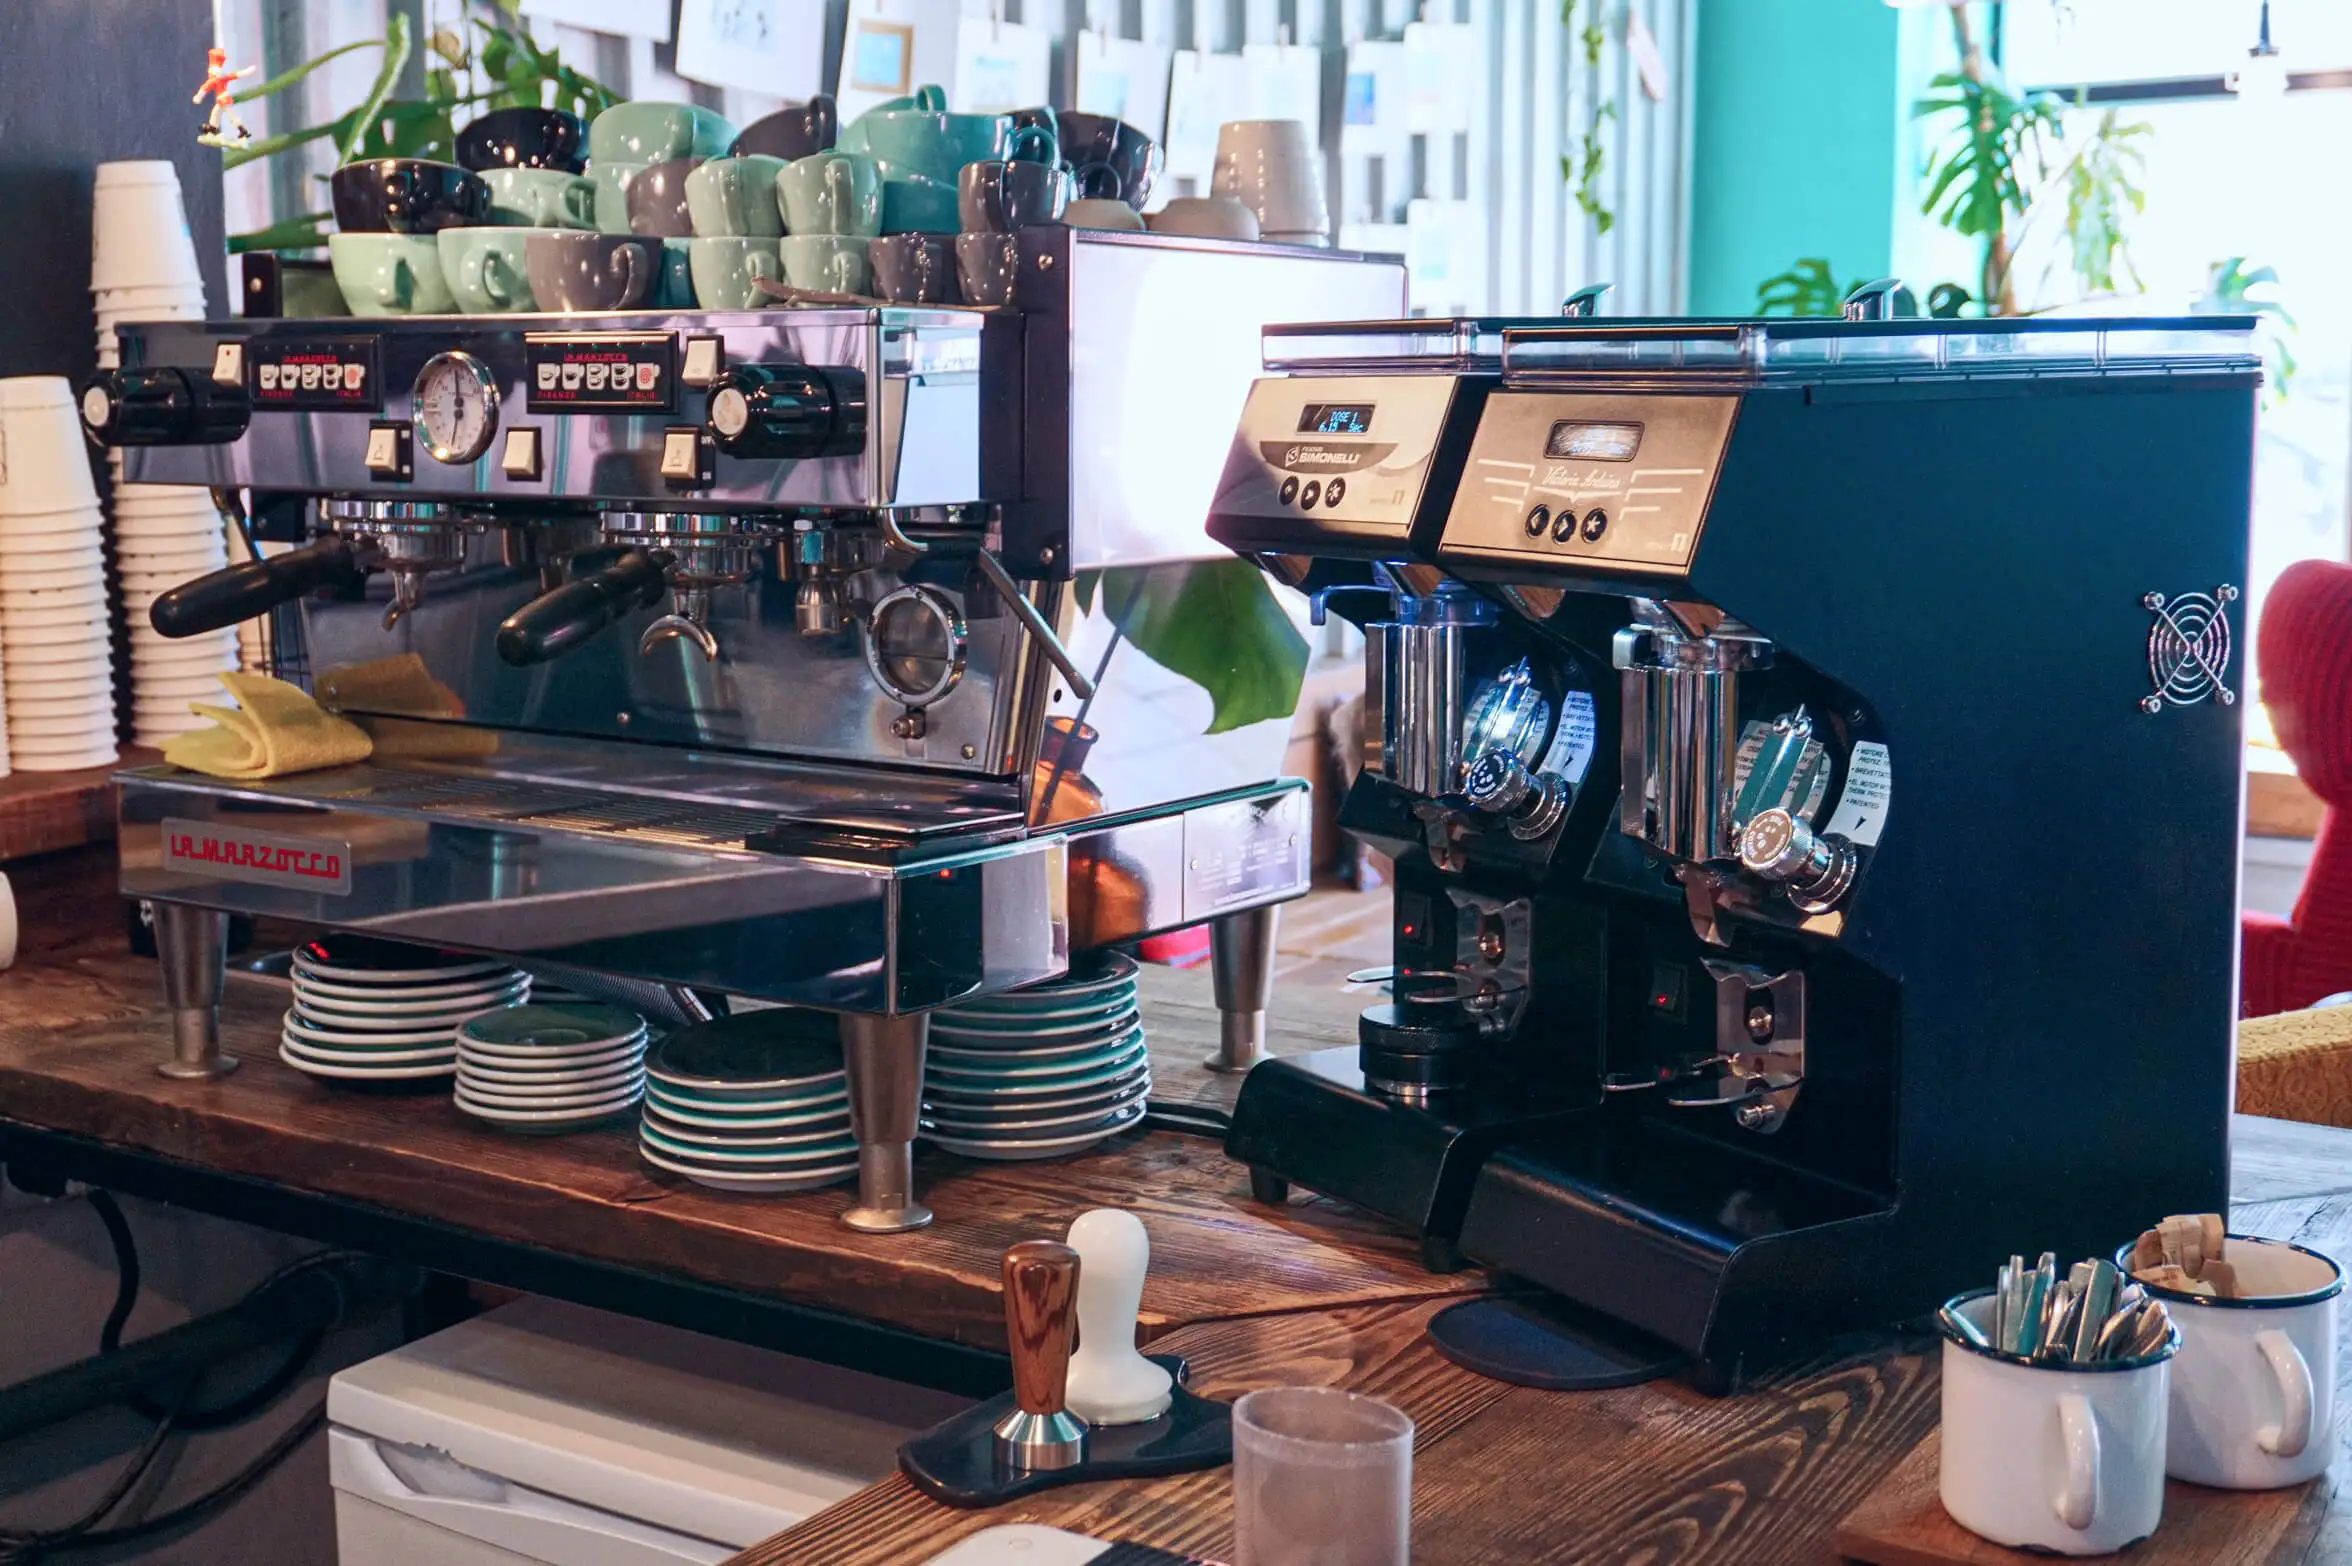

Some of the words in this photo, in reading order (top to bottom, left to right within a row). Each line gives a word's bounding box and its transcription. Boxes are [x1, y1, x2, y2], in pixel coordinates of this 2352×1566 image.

[1299, 452, 1361, 464] SIMONELLI
[171, 832, 198, 858] LA
[200, 838, 341, 880] MARZOCCO
